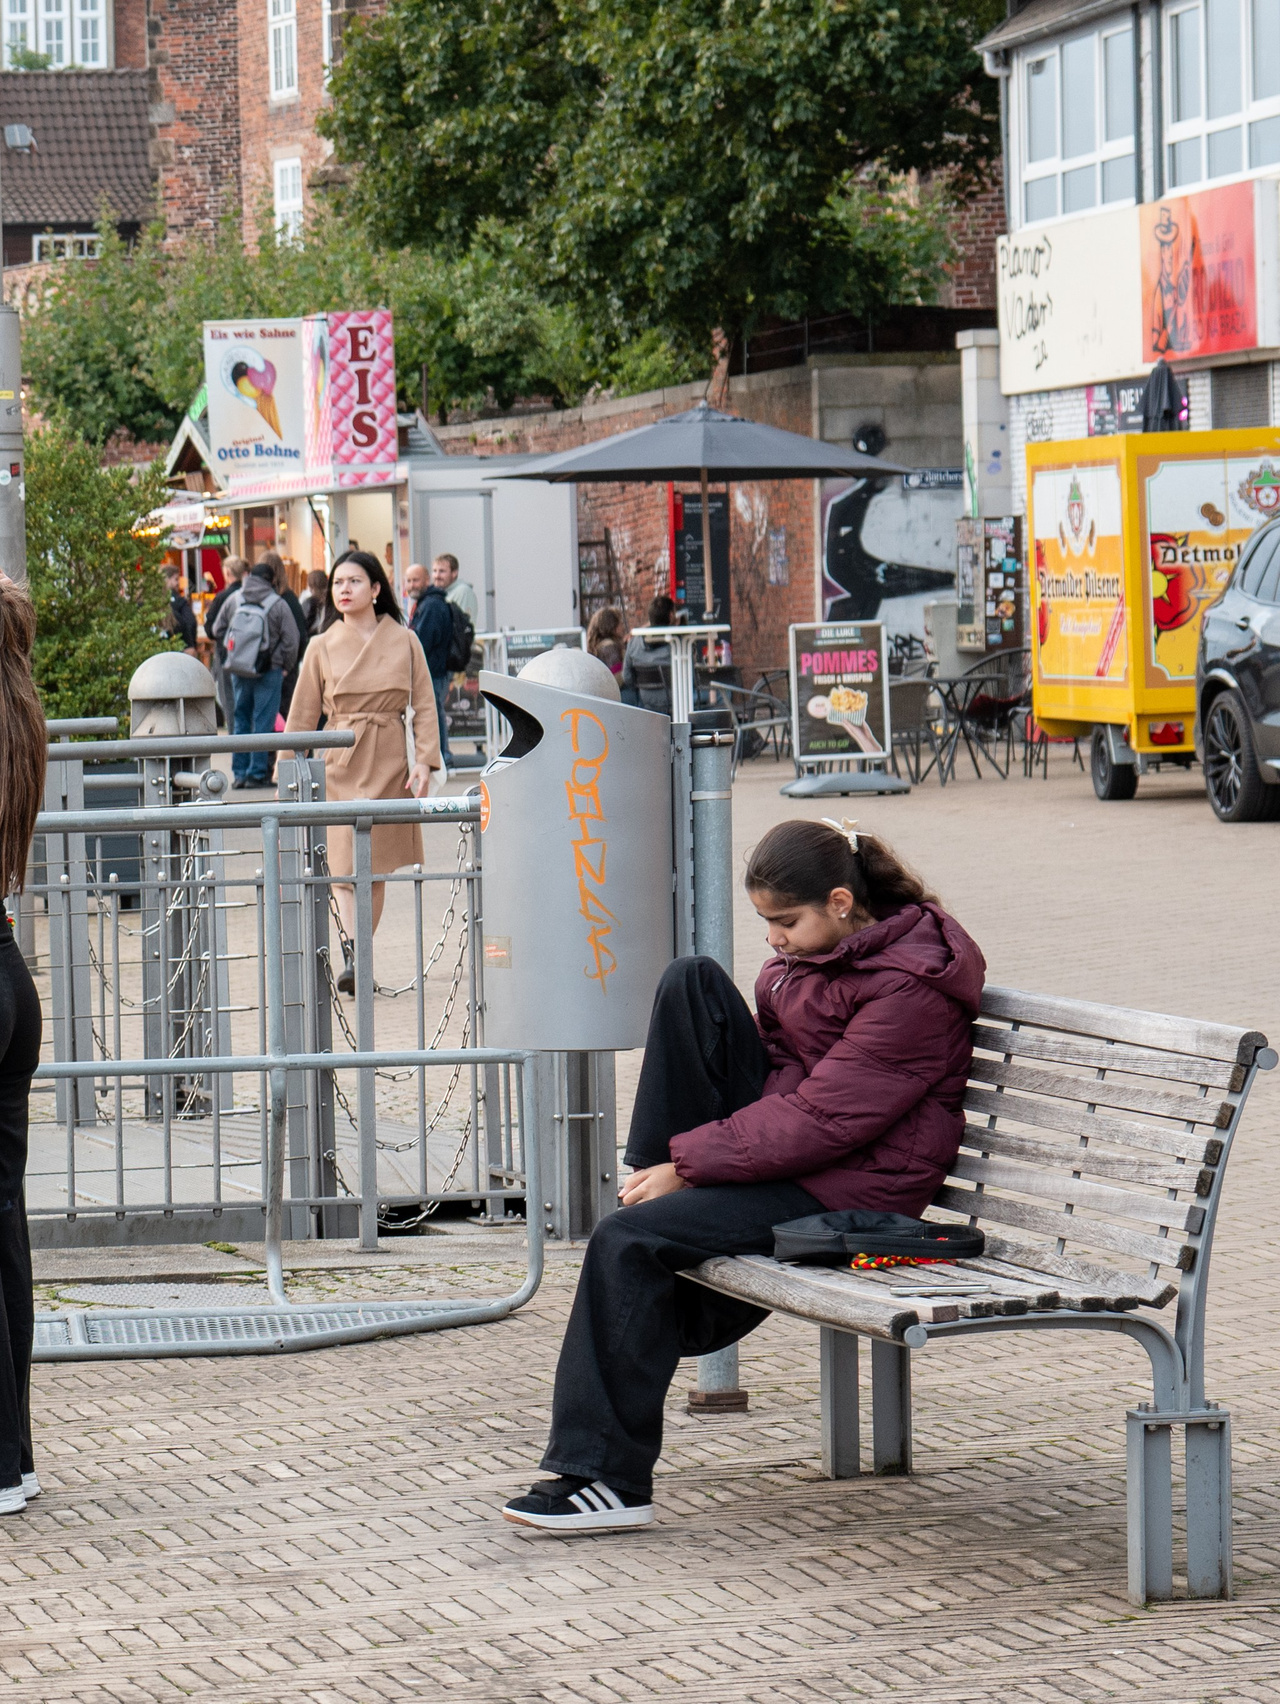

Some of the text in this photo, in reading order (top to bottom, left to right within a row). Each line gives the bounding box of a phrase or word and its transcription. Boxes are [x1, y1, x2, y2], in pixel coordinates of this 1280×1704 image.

[210, 328, 296, 340] Eis wie Sahne
[347, 325, 378, 448] EIS
[217, 444, 300, 461] Otto Bohne
[1040, 570, 1120, 601] Detmolder Pilsener
[801, 650, 878, 676] POMMES
